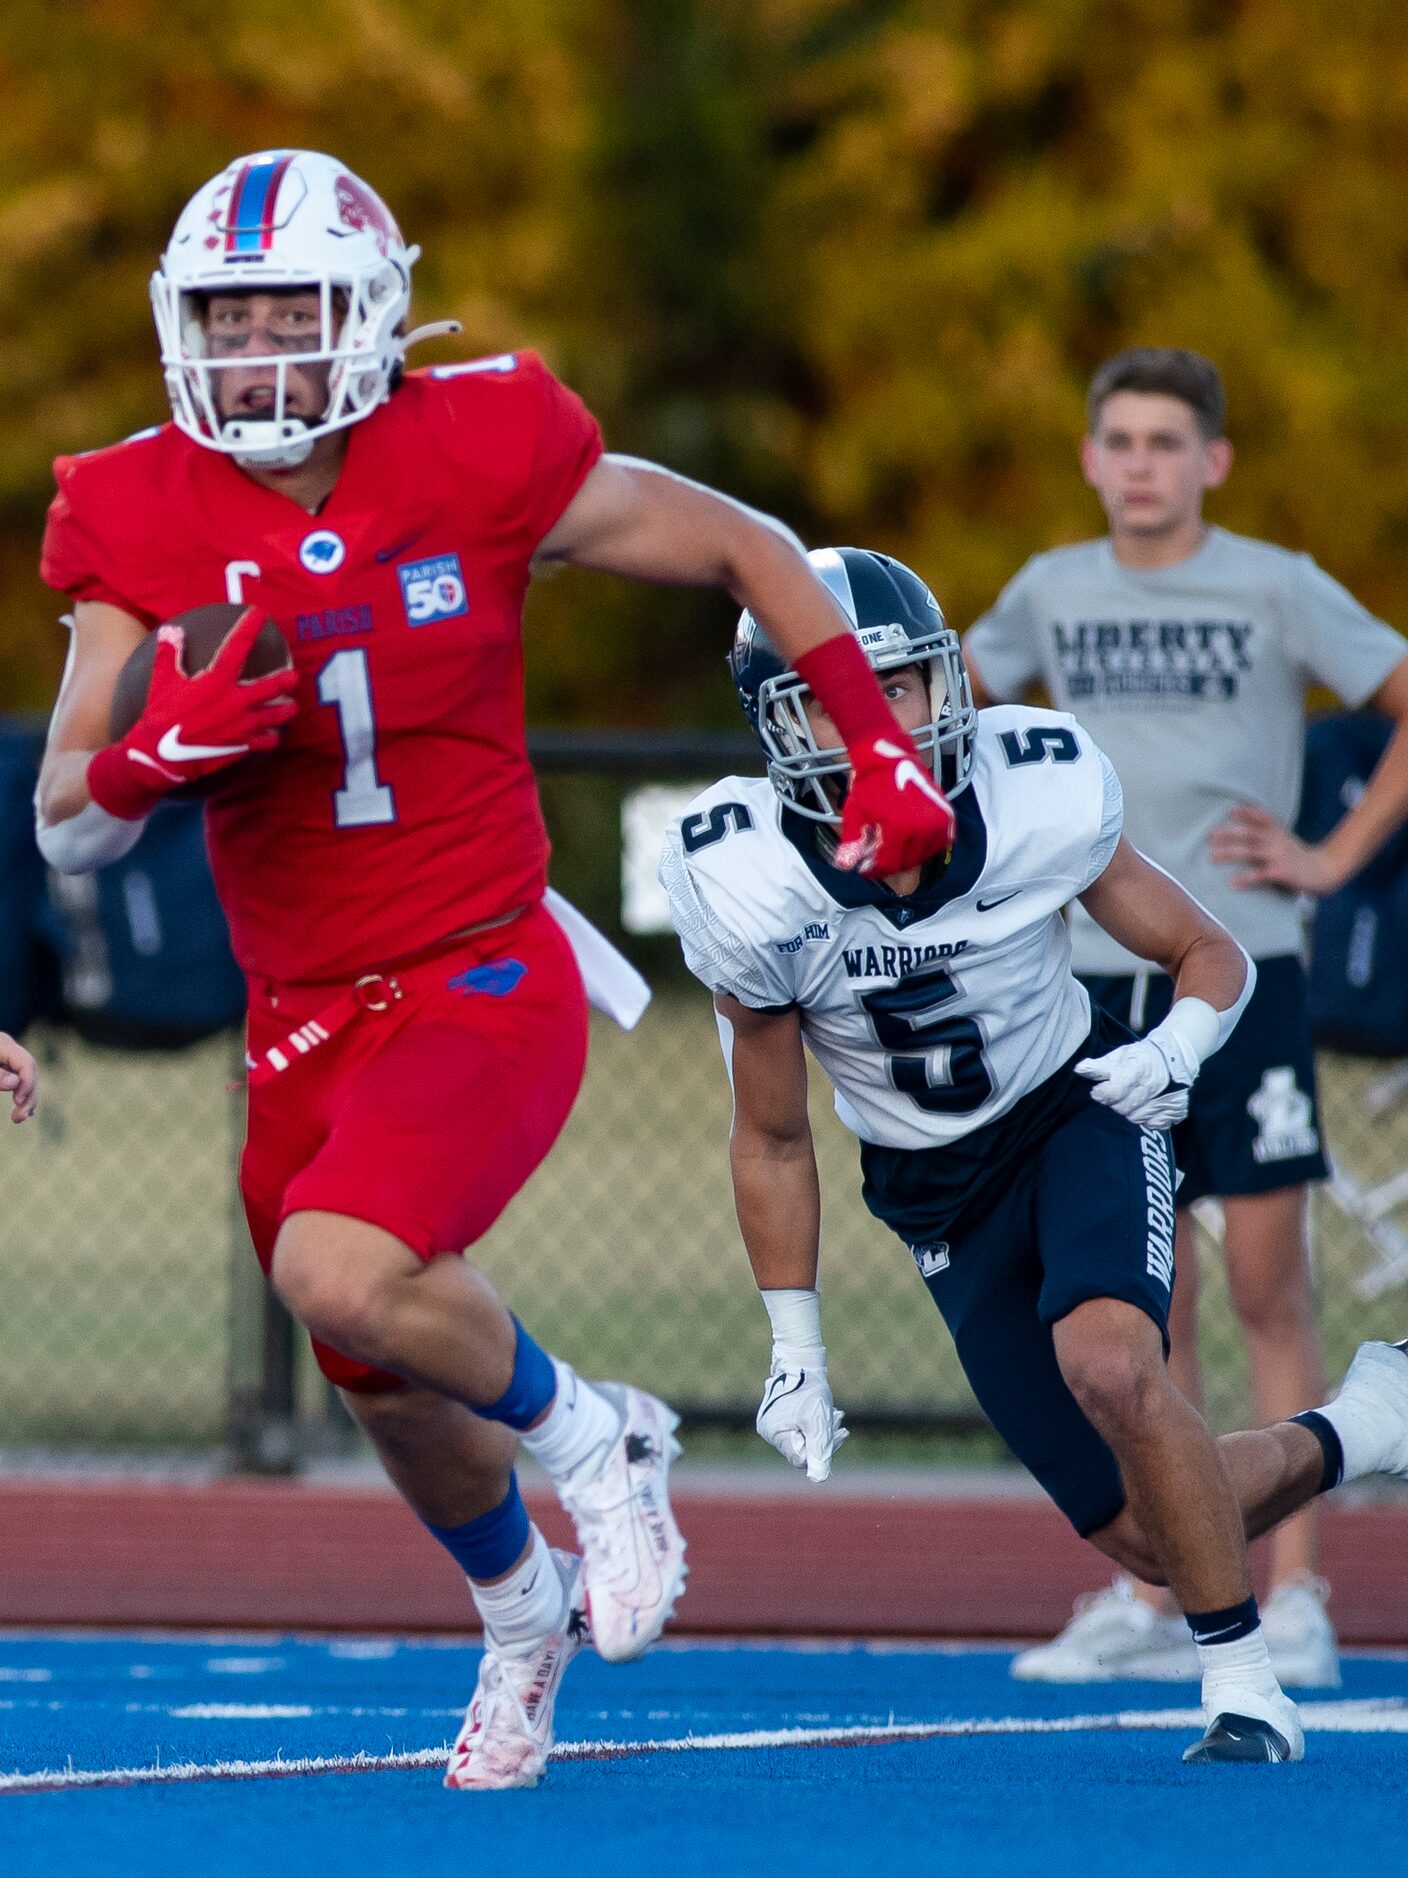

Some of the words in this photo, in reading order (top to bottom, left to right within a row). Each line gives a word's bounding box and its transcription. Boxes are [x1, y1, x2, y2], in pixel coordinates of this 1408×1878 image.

[401, 559, 458, 582] PARISH
[407, 574, 464, 619] 50
[1052, 620, 1251, 653] LIBERTY
[315, 648, 398, 829] 1
[995, 726, 1083, 770] 5
[681, 802, 756, 856] 5
[776, 936, 803, 953] FOR
[804, 924, 830, 940] HIM
[853, 958, 1001, 1118] 5
[1140, 1124, 1175, 1293] WARRIORS
